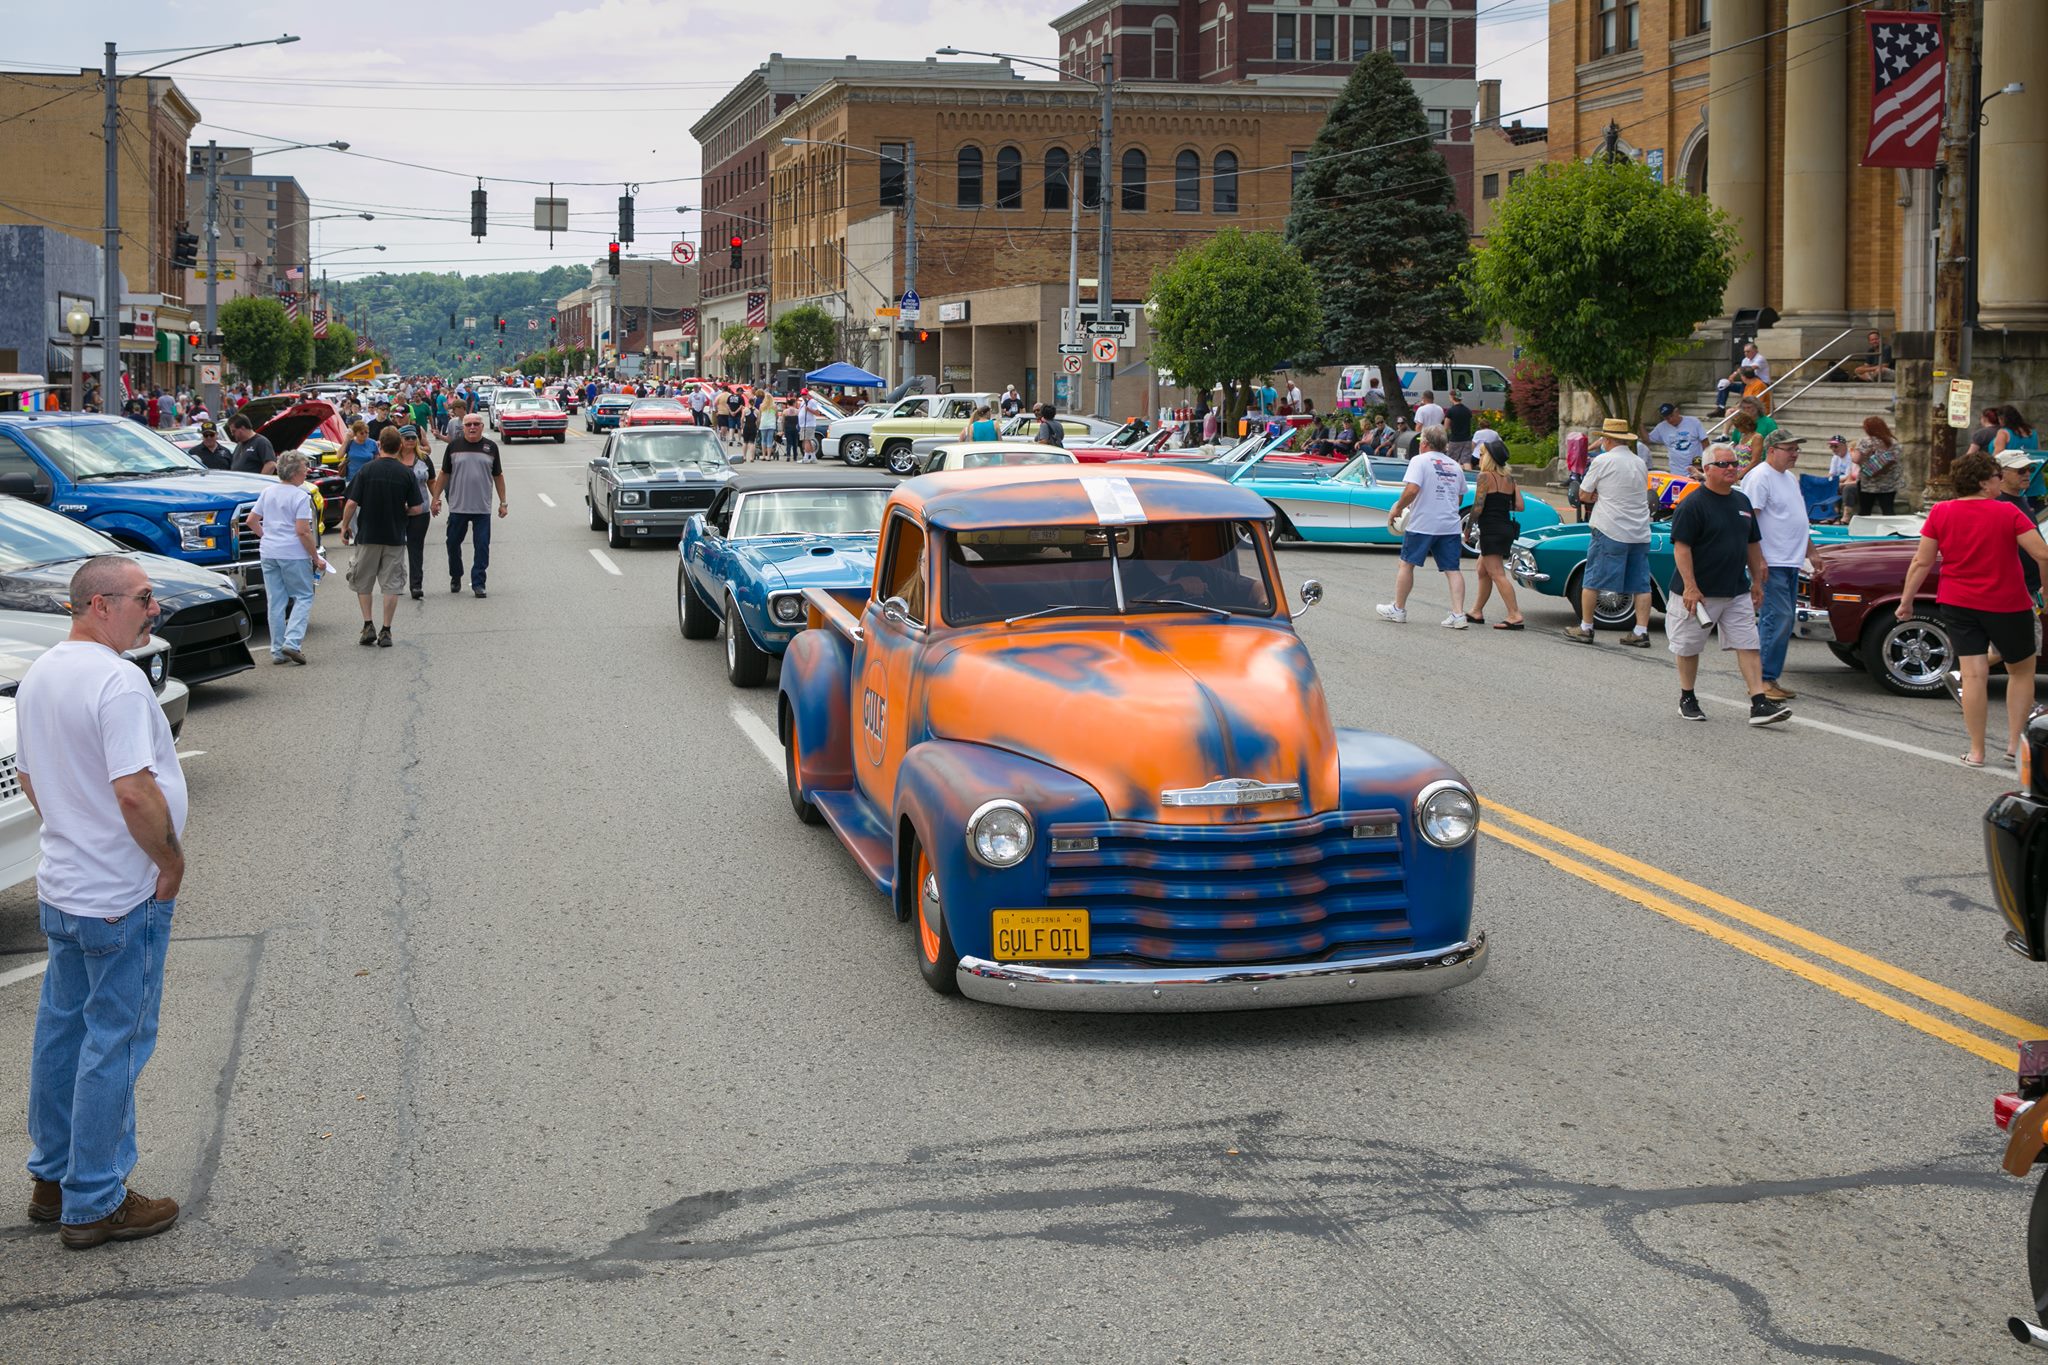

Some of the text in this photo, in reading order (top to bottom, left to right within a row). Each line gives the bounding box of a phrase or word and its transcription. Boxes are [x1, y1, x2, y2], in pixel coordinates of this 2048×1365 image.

[864, 687, 886, 742] GULF
[1000, 929, 1085, 952] GULF OIL
